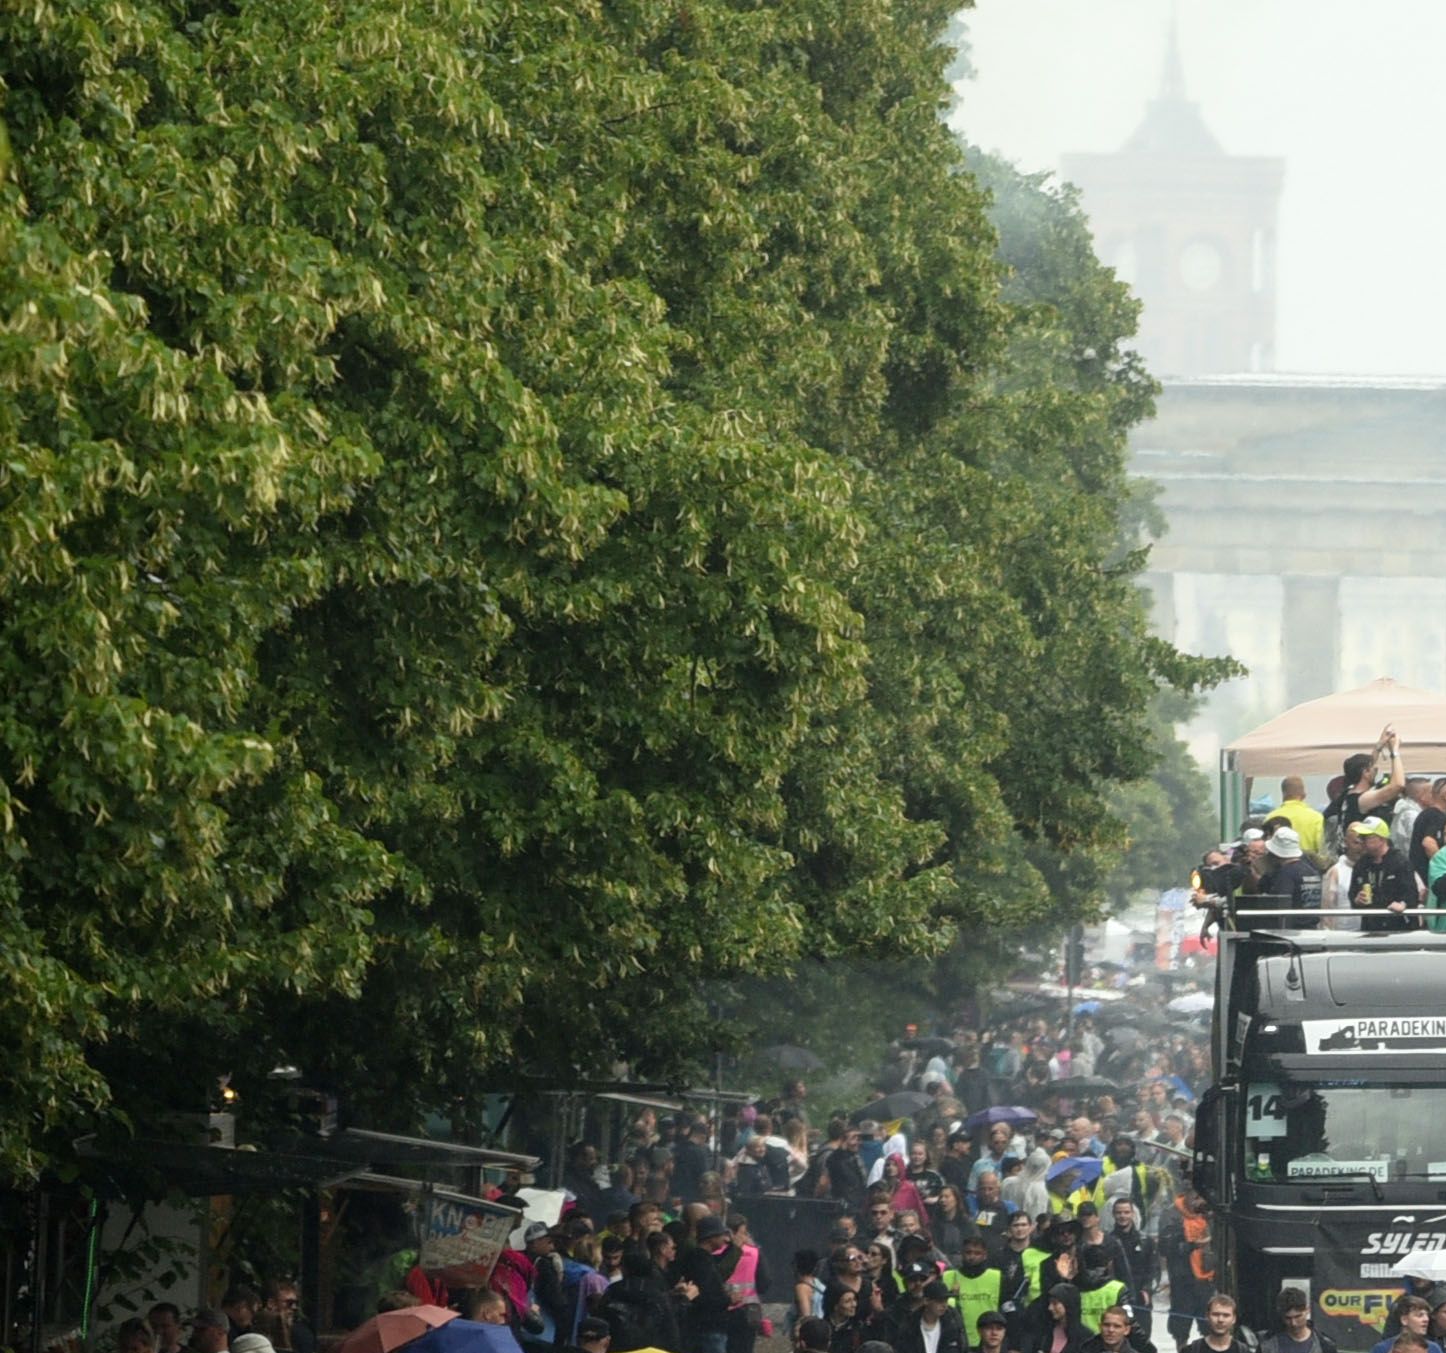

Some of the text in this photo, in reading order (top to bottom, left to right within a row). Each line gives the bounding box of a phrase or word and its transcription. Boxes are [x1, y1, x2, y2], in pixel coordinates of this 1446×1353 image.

[1248, 1094, 1287, 1121] 14
[1291, 1167, 1385, 1177] PARADEKINGDE
[1324, 1295, 1362, 1307] OUR
